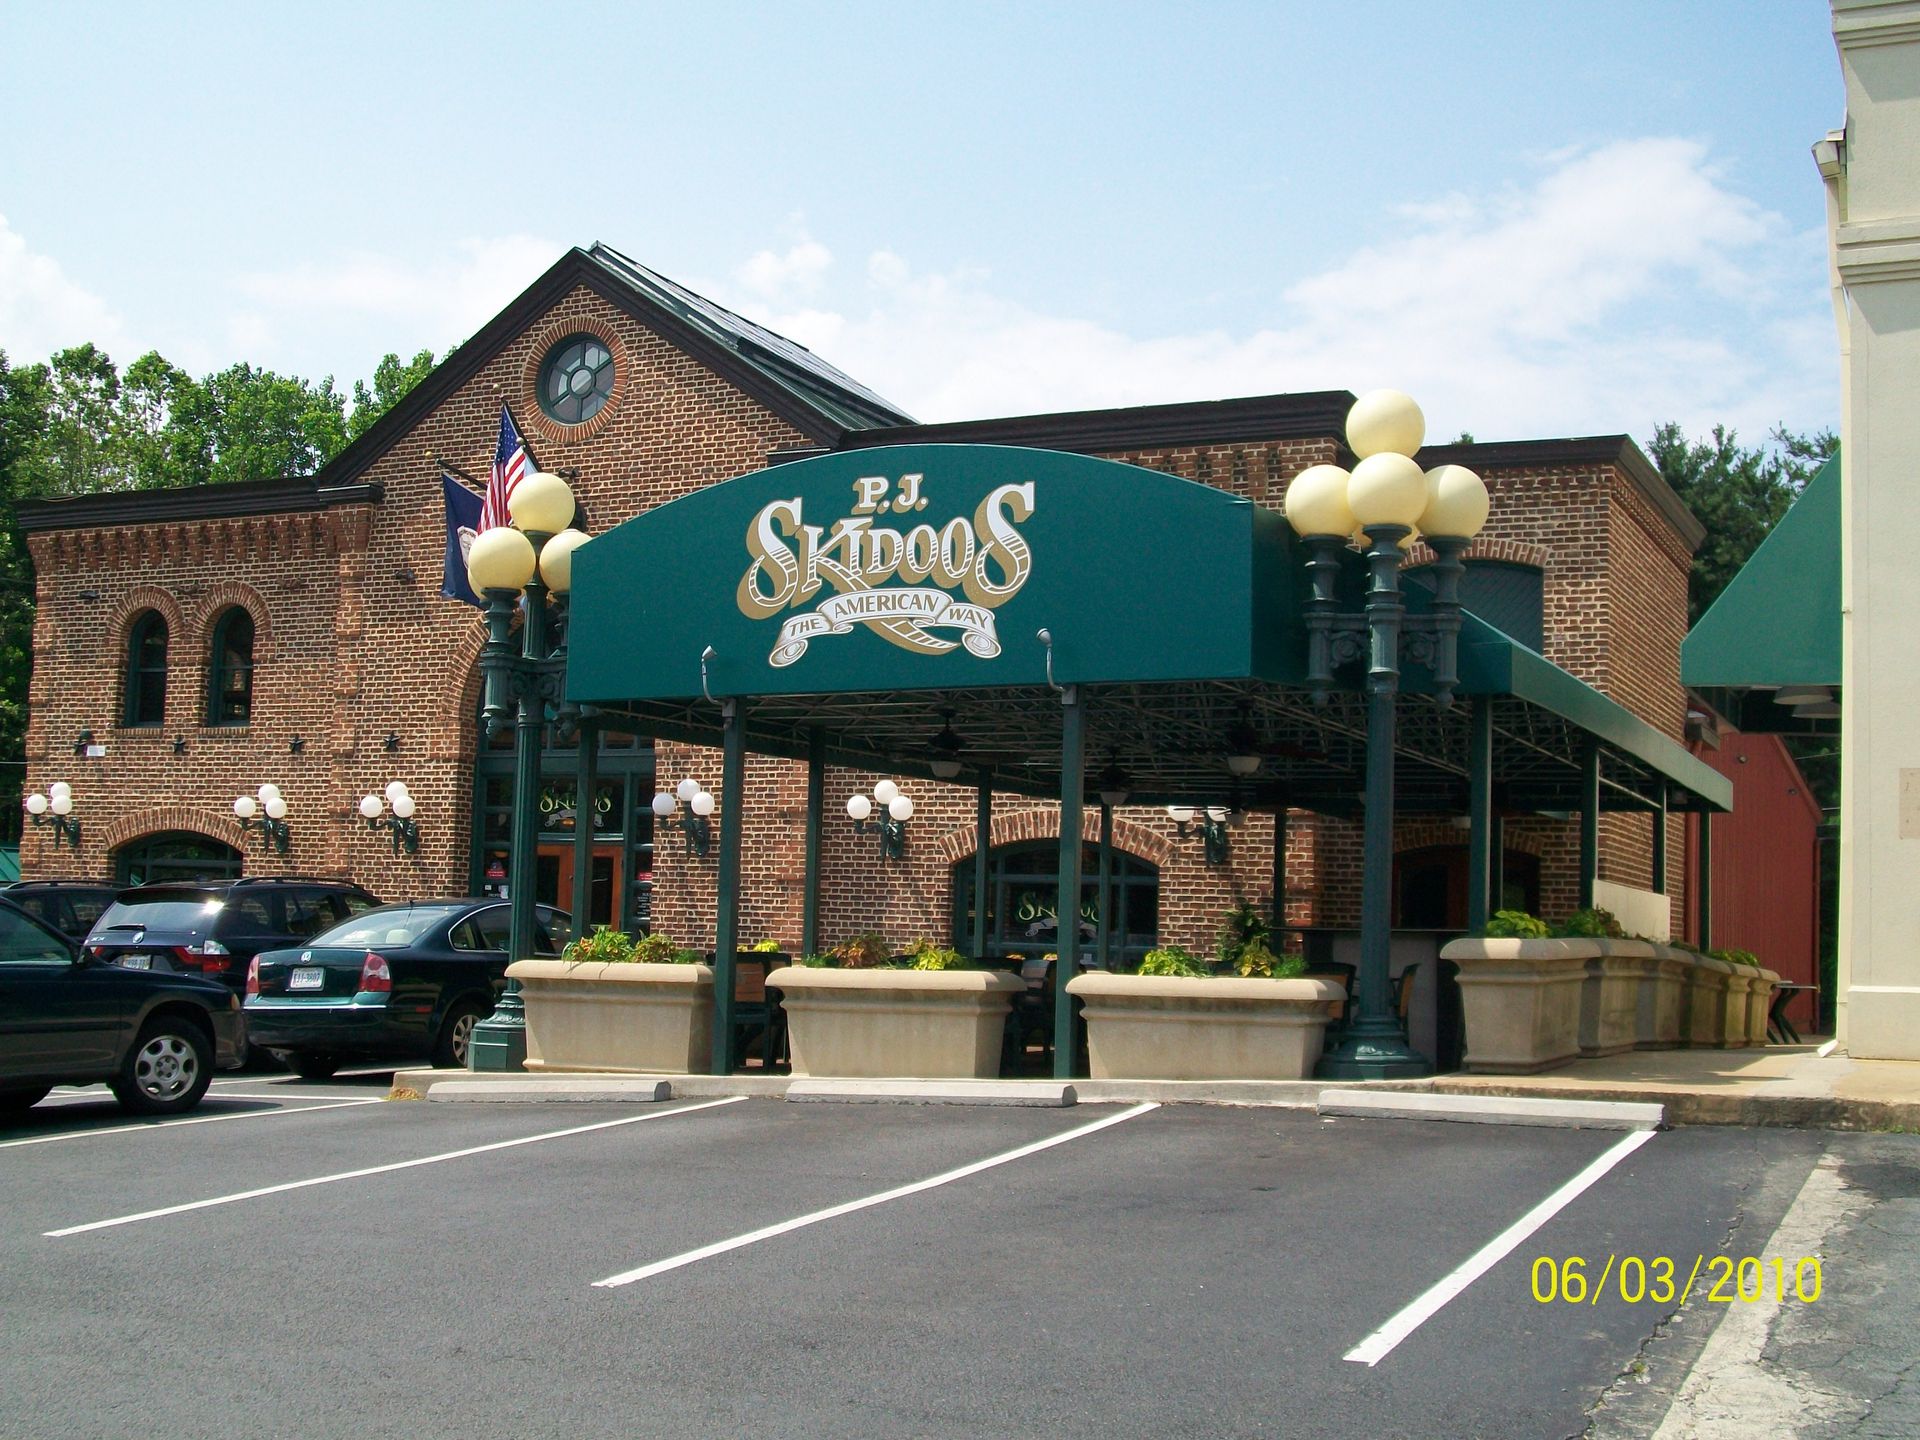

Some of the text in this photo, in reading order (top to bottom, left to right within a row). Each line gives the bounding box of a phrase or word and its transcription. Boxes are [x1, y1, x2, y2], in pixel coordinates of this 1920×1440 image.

[852, 473, 929, 514] P.J.
[737, 481, 1036, 620] SKIDOOS
[789, 592, 989, 638] THE AMERICAN WAY
